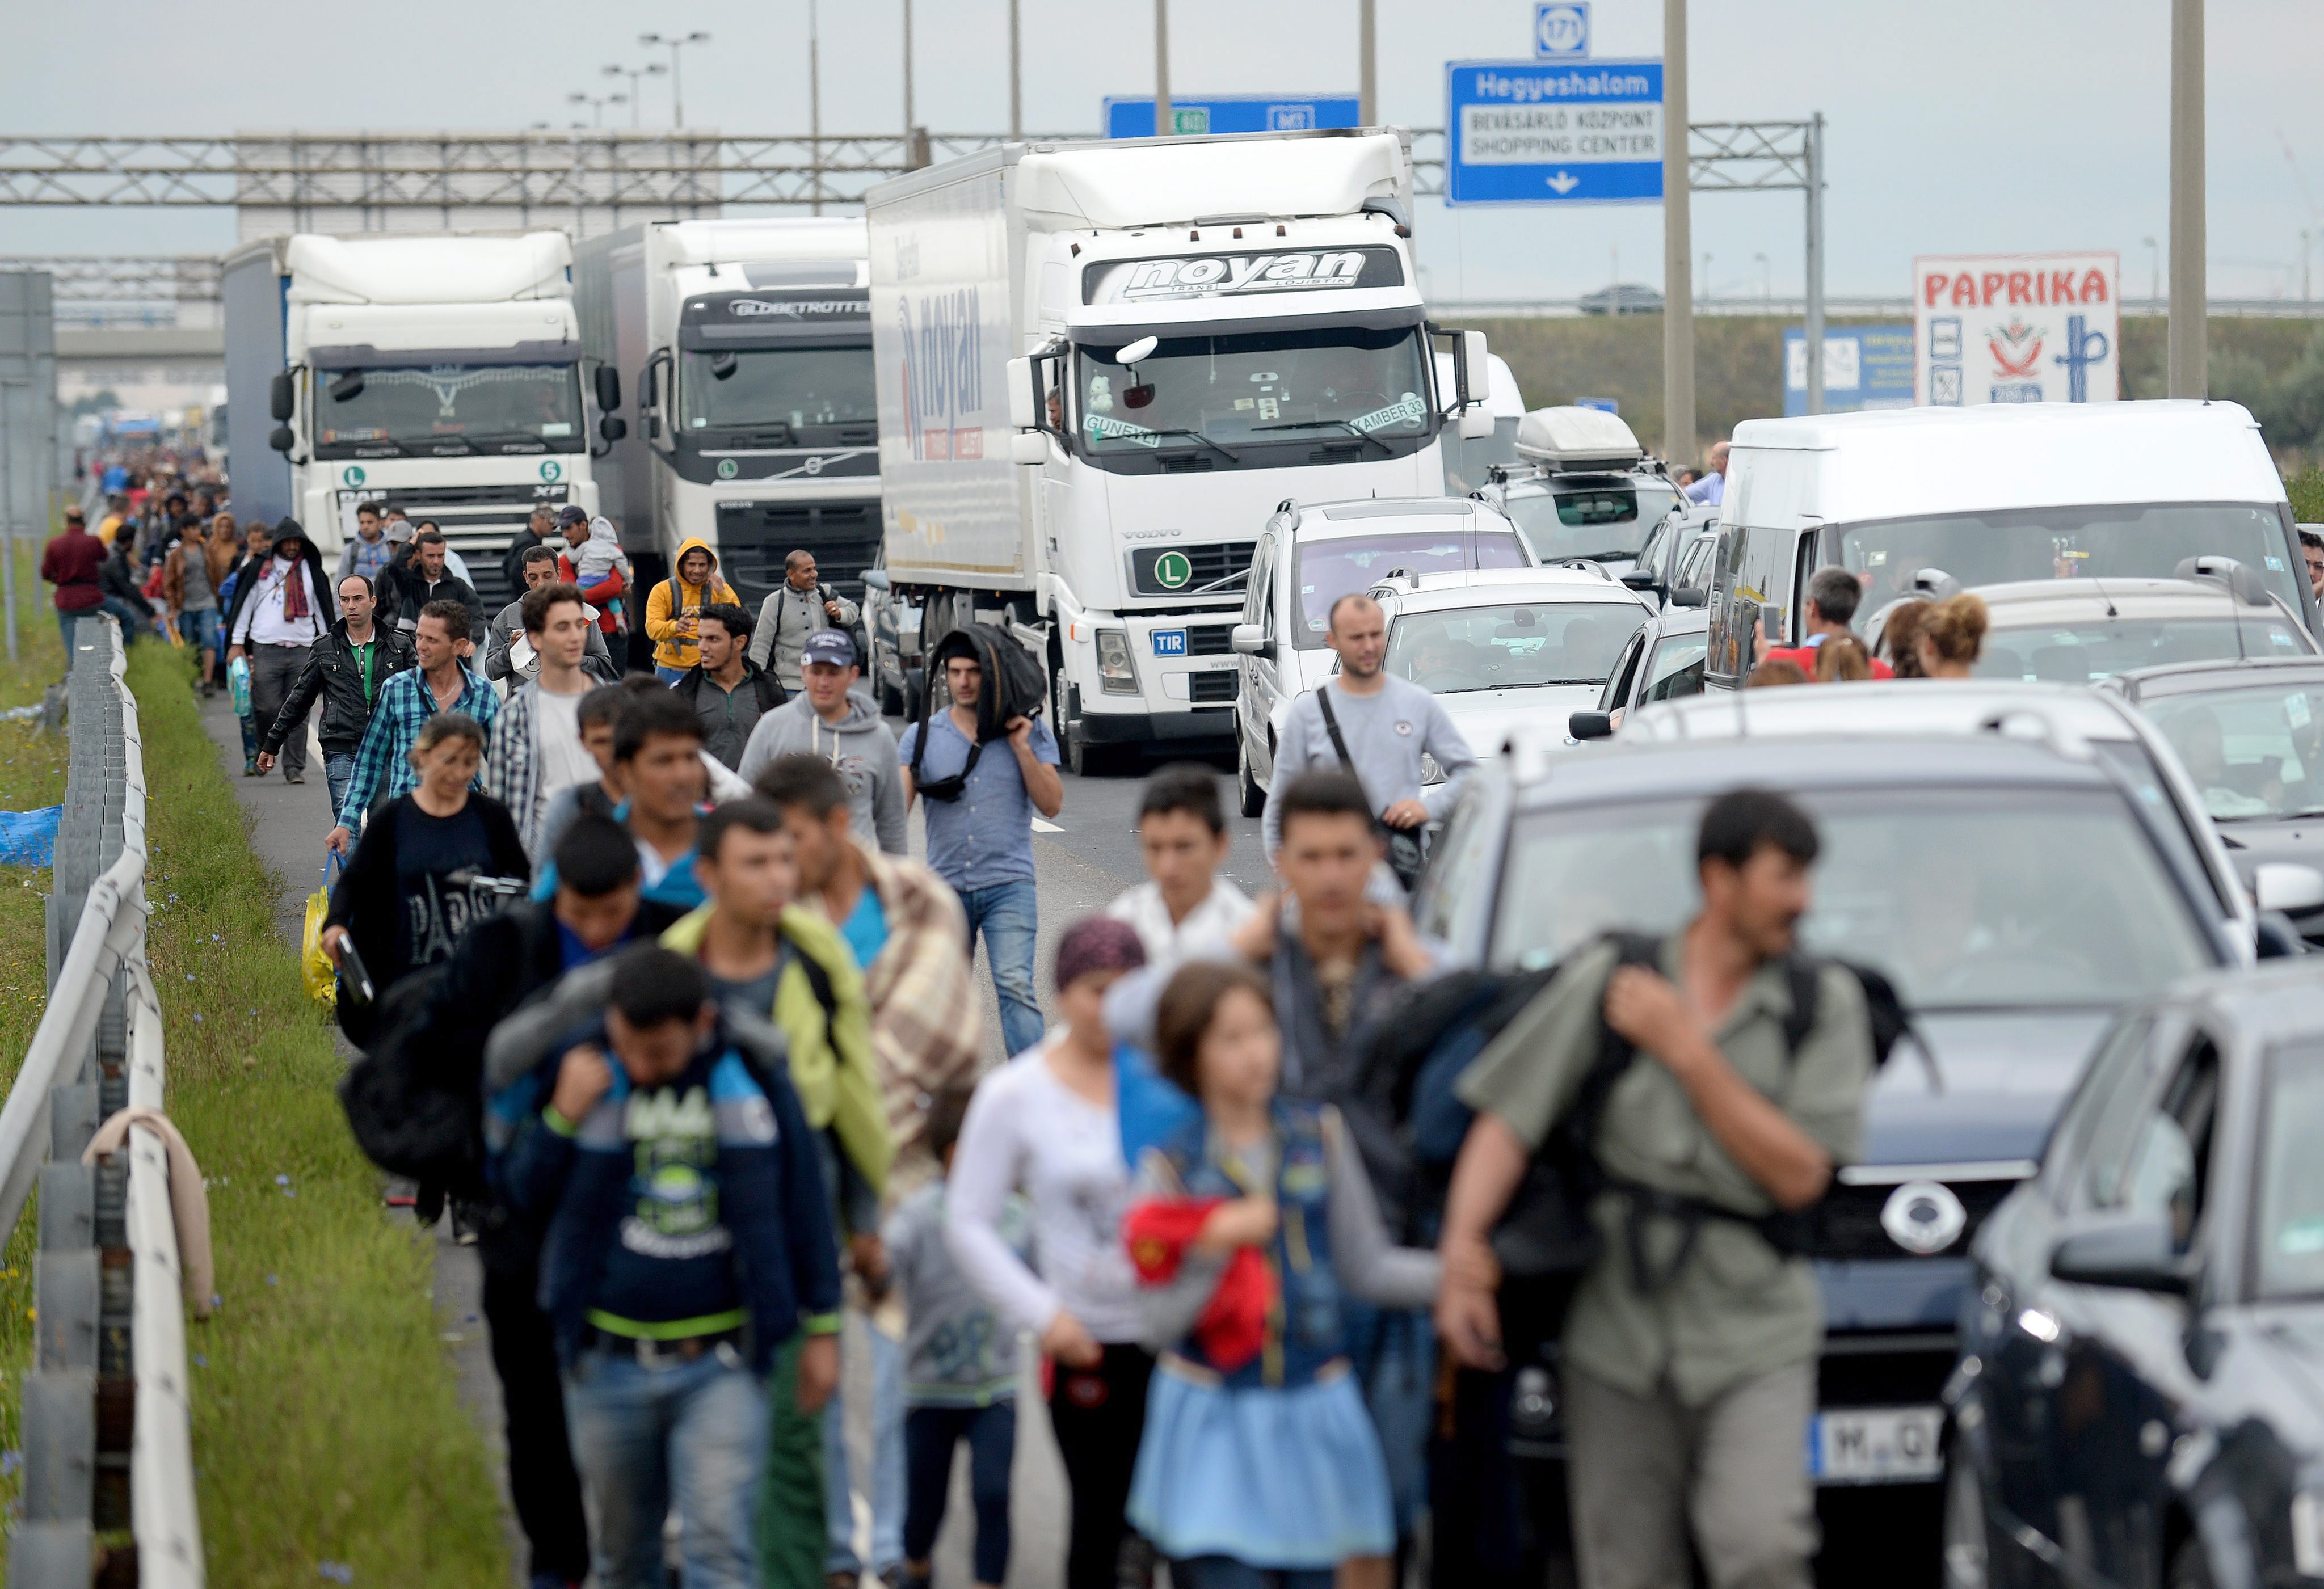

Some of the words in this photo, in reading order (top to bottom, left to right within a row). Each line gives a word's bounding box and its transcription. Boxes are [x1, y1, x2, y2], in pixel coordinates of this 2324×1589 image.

[1547, 19, 1580, 39] 171
[1476, 73, 1649, 101] Hegyeshalom
[1472, 136, 1571, 156] SHOPPING
[1577, 134, 1656, 154] CENTER
[1127, 252, 1366, 291] noyan
[1171, 284, 1213, 292] TRANS
[1925, 268, 2109, 306] PAPRIKA
[737, 300, 872, 317] GLOBETROTTE
[1409, 400, 1424, 414] 33
[348, 468, 363, 484] L
[1121, 529, 1181, 538] VOLVO
[1165, 559, 1181, 581] L
[1157, 635, 1182, 650] TIR
